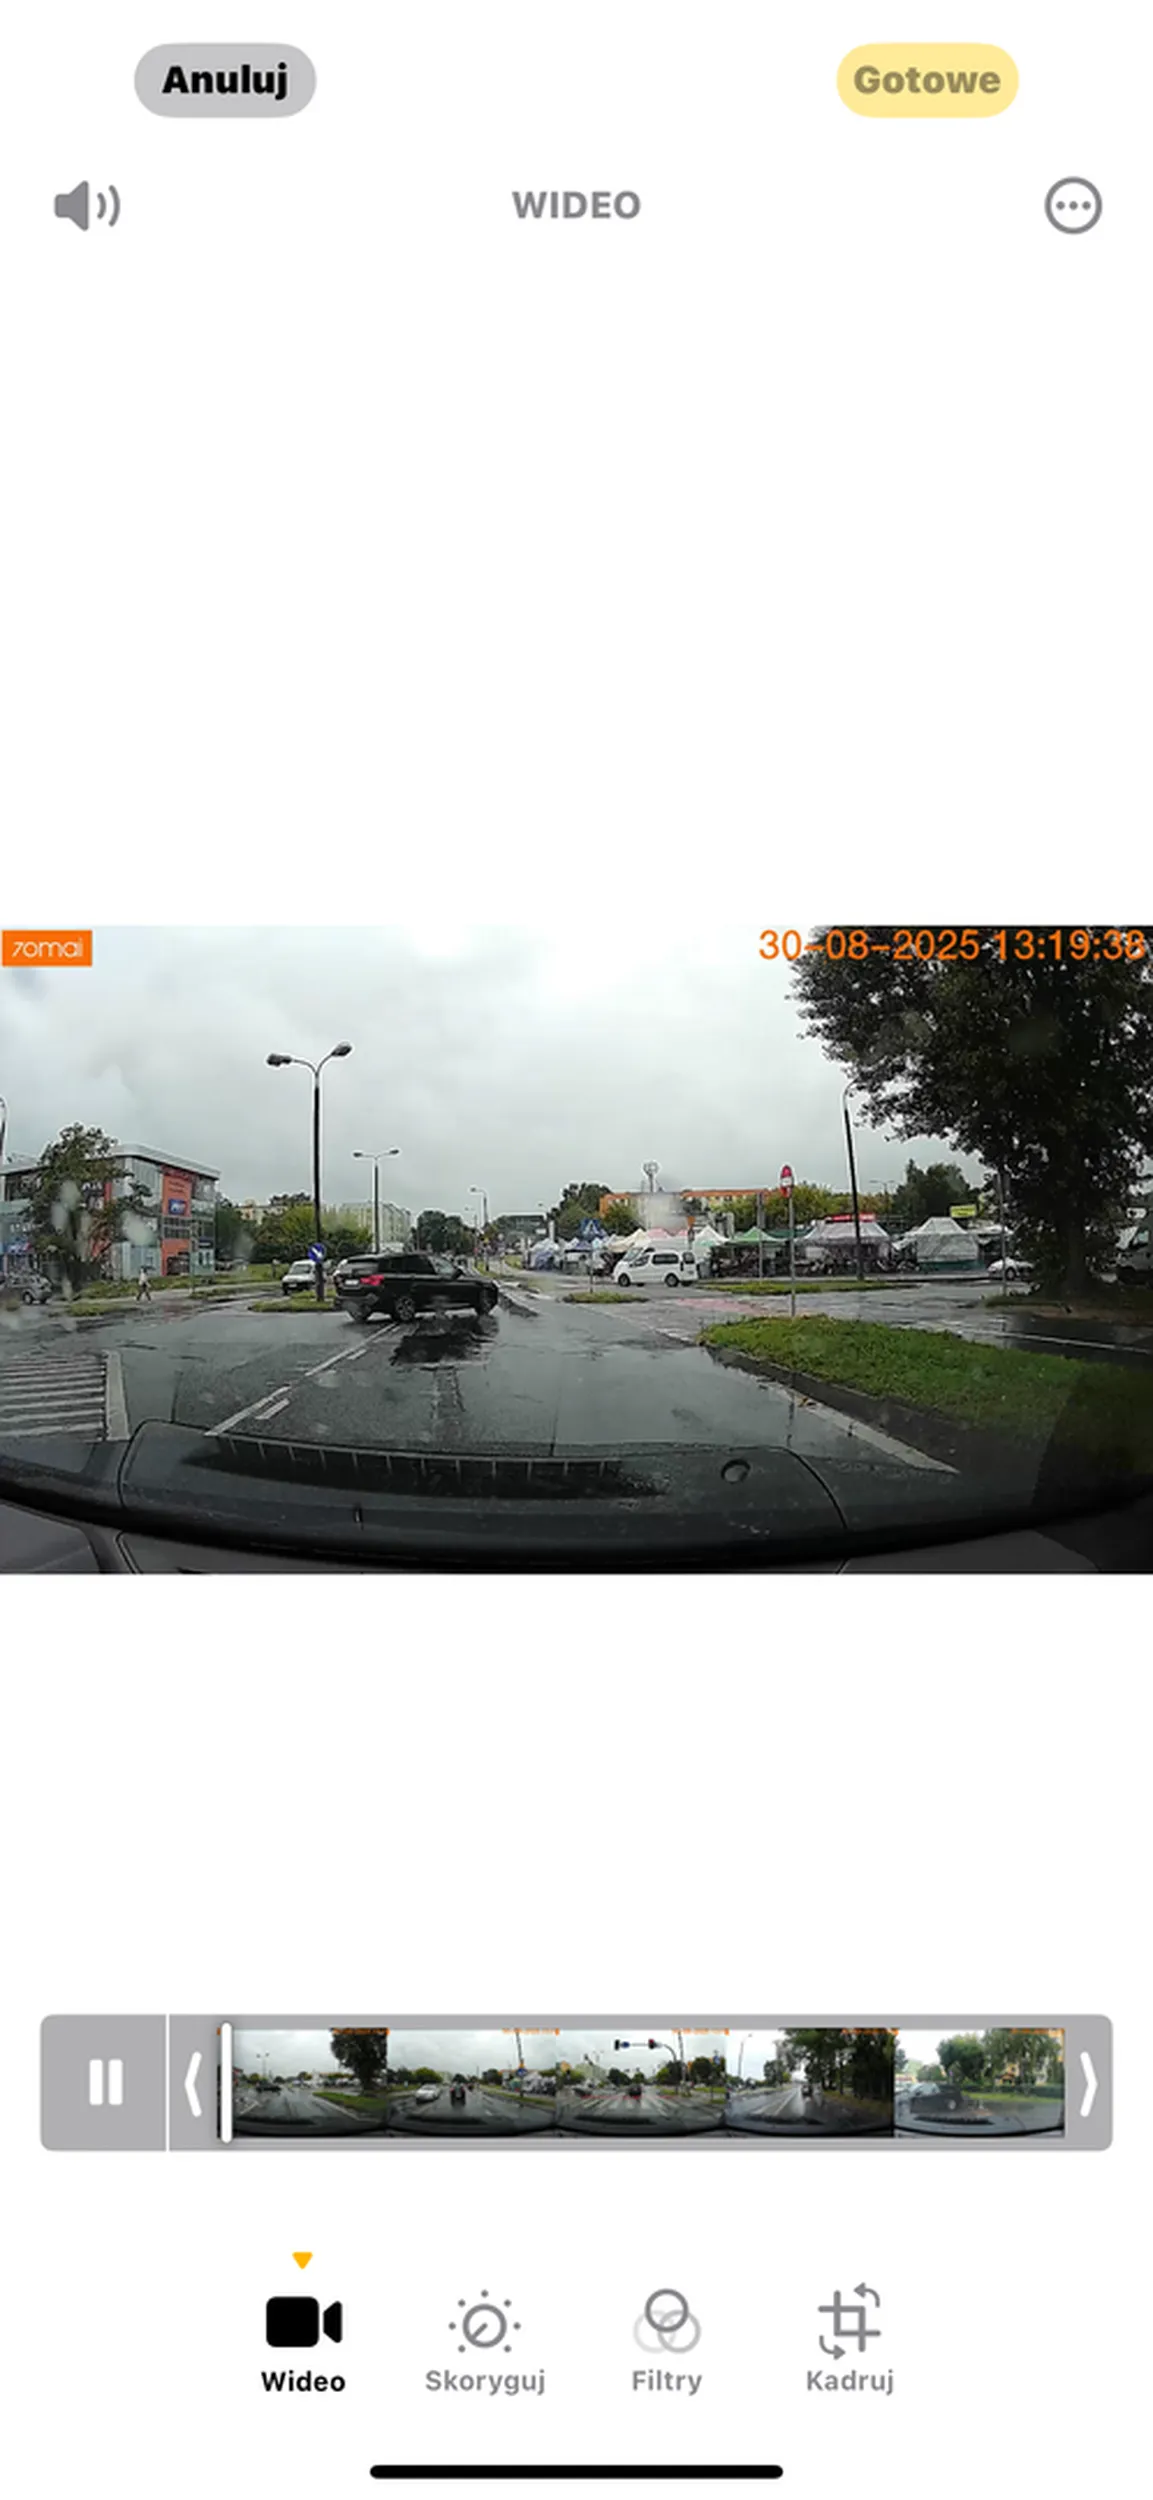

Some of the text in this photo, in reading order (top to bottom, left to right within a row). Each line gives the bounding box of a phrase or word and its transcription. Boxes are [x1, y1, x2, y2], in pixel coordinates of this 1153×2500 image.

[161, 62, 288, 101] Anuluj
[854, 65, 1001, 96] Gotowe
[511, 190, 641, 220] WIDEO
[260, 2369, 346, 2393] Wideo
[425, 2368, 547, 2398] Skoryguj
[632, 2368, 704, 2398] Filtry
[807, 2368, 895, 2398] Kadruj
